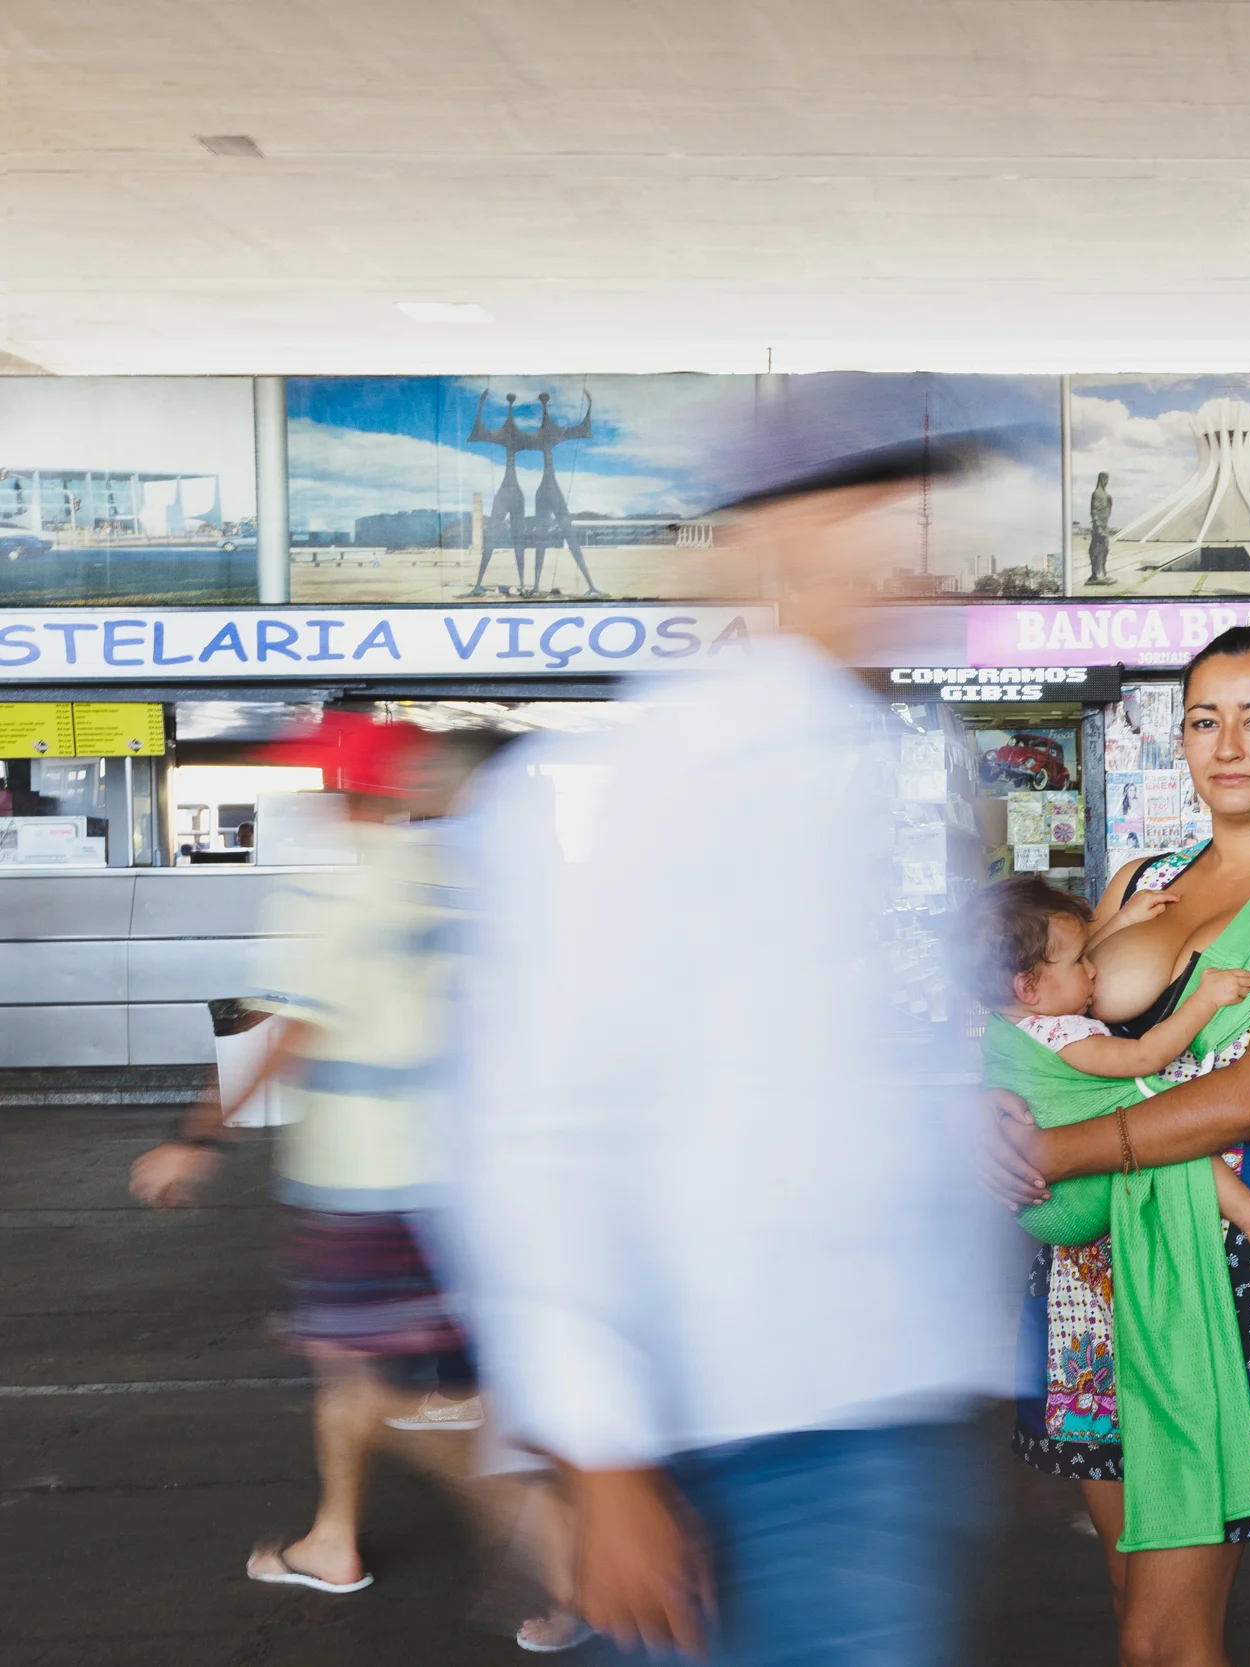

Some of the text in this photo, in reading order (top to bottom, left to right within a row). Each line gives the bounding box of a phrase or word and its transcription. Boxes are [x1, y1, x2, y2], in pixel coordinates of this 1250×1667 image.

[0, 616, 755, 669] STELARIA VIÇOSA
[1017, 609, 1171, 650] BANCA
[890, 667, 1088, 684] COMPRAMOS
[941, 685, 1043, 701] GIBIS
